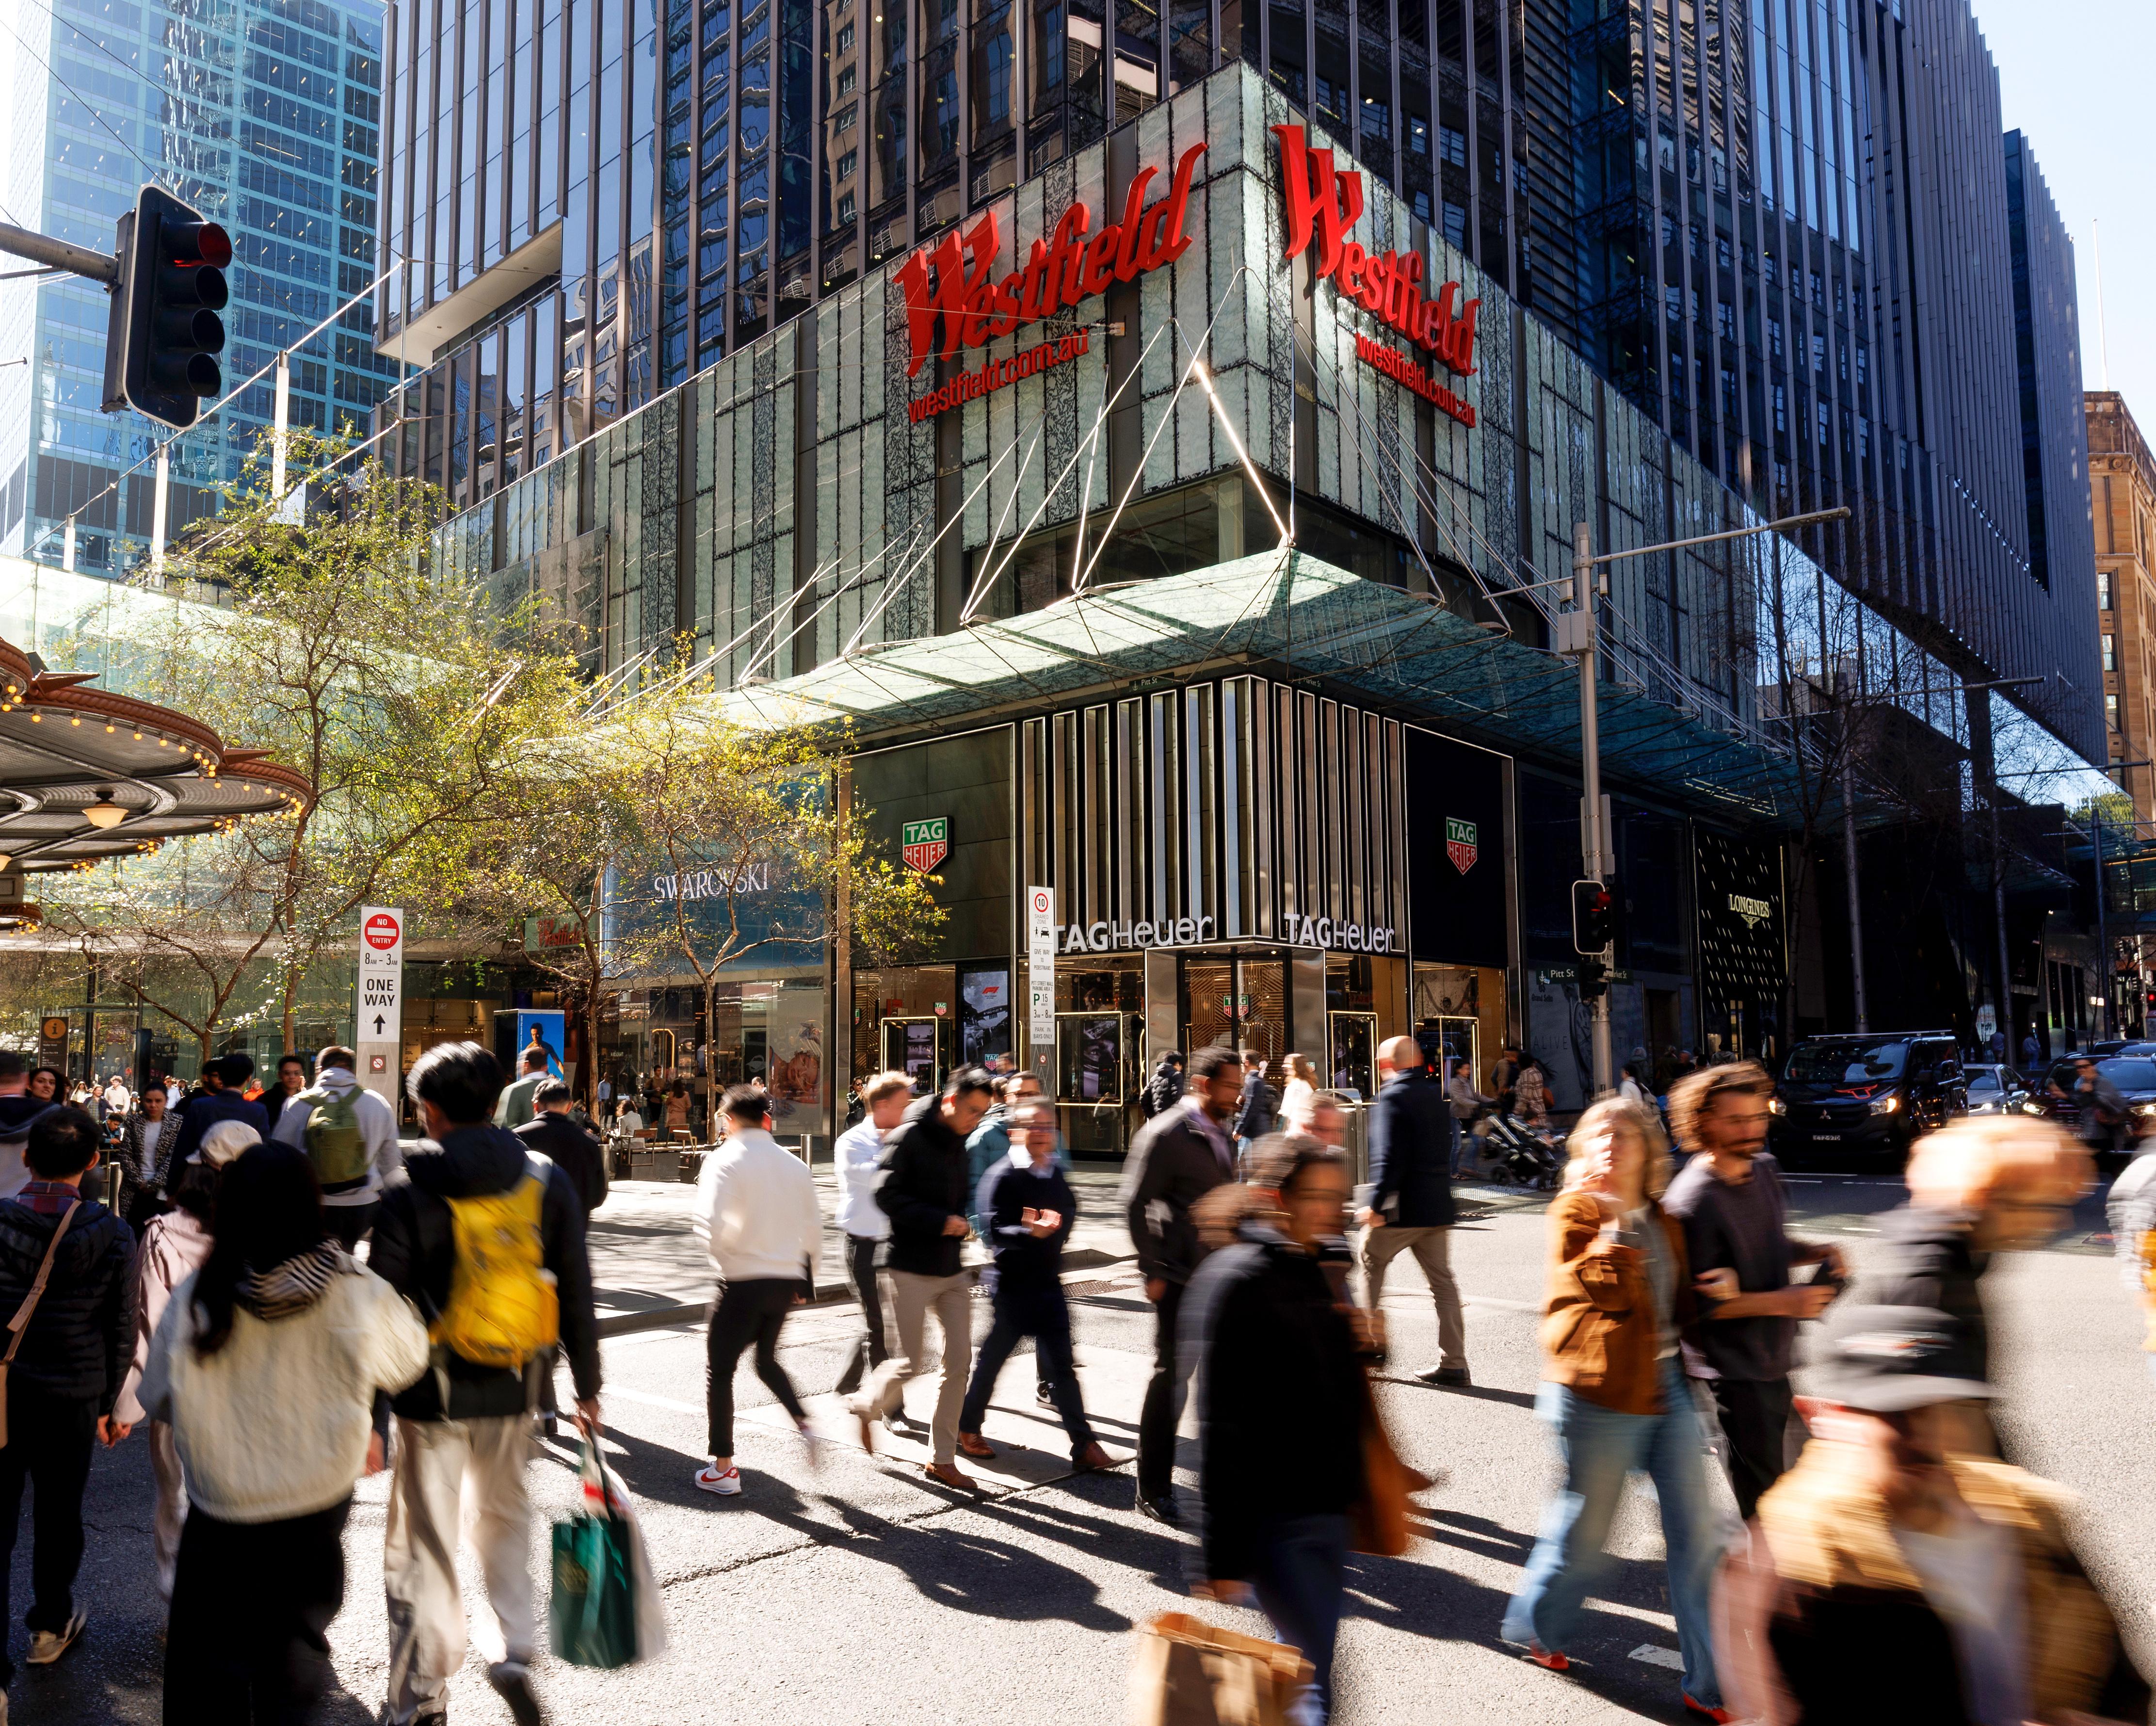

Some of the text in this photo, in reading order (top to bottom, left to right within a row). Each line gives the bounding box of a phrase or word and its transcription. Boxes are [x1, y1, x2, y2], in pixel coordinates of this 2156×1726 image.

[893, 142, 1207, 377] Westfield
[1271, 125, 1481, 376] Westfield
[908, 328, 1089, 422] westfield.com.au
[1355, 332, 1476, 428] westfield.com.au
[906, 822, 943, 842] TAG
[1449, 822, 1474, 843] TAG
[905, 843, 944, 871] HEUER
[1449, 843, 1475, 871] HEUER
[654, 862, 769, 903] SWAROVSKI
[1038, 899, 1045, 907] 10
[1729, 893, 1770, 918] LONGINES
[1601, 953, 1613, 963] WAY
[367, 979, 394, 991] ONE
[1551, 969, 1575, 978] Pitt St
[365, 994, 395, 1006] WAY
[1033, 993, 1048, 1006] P 15
